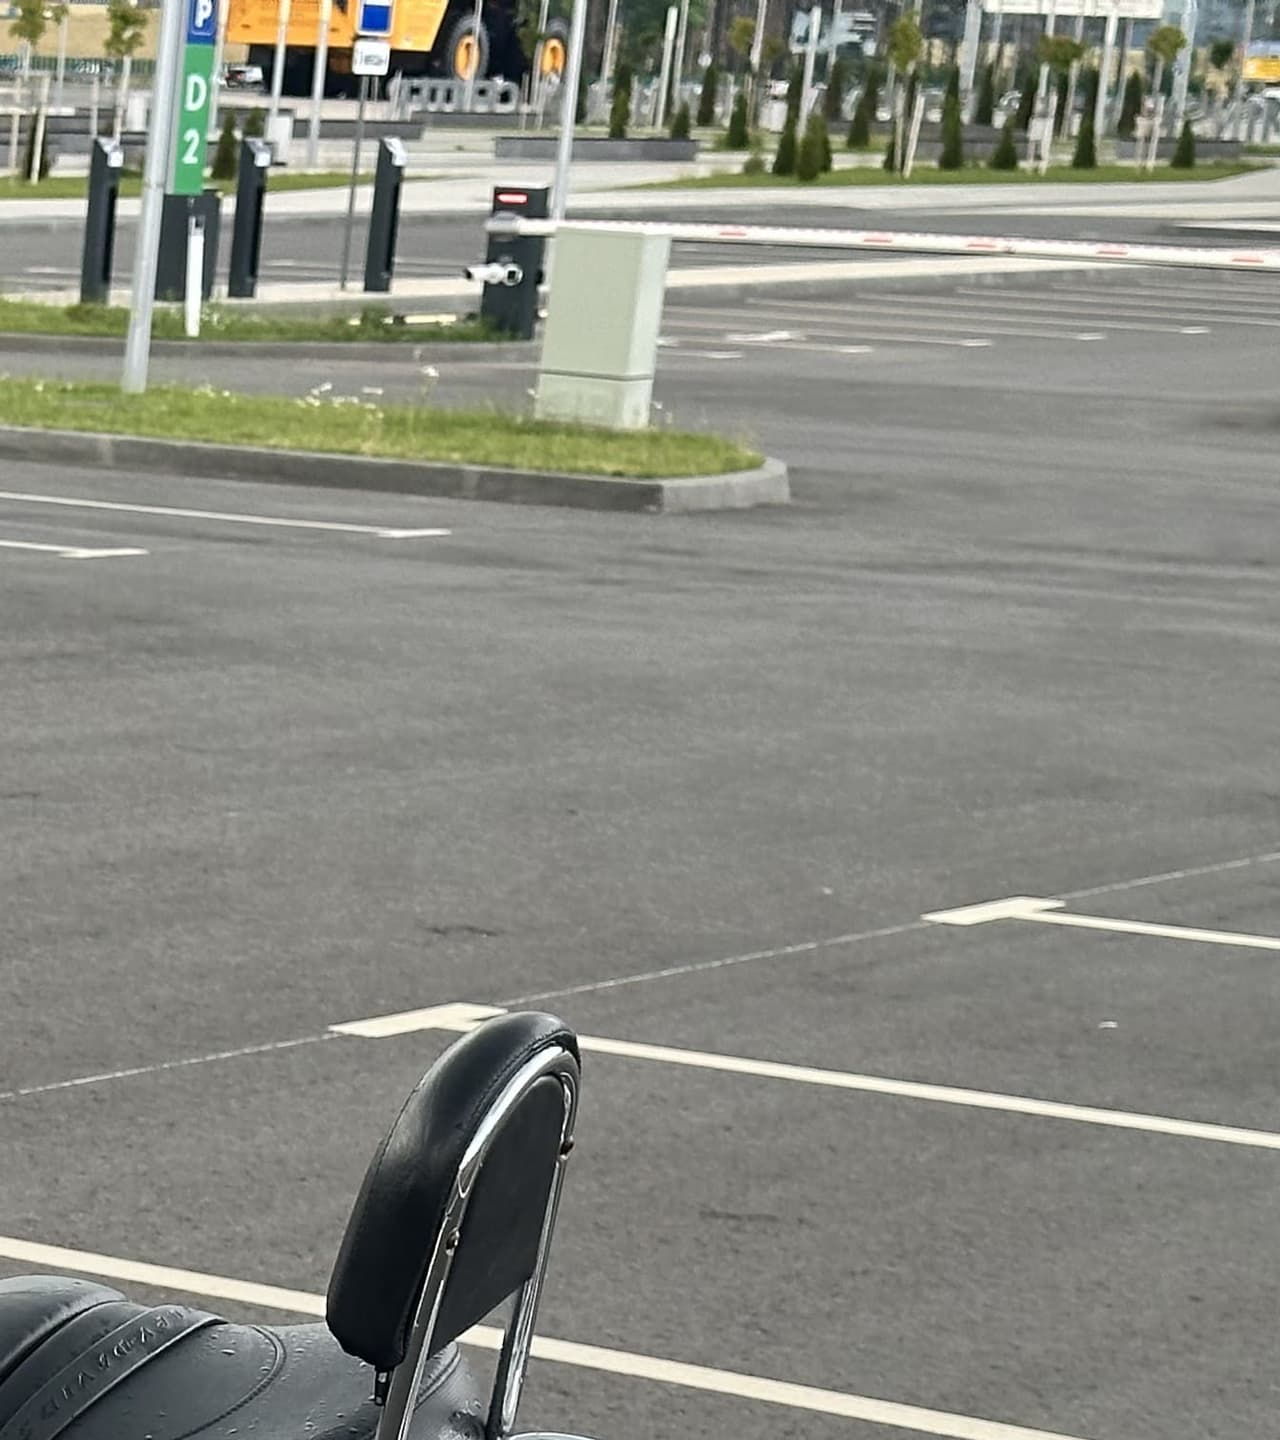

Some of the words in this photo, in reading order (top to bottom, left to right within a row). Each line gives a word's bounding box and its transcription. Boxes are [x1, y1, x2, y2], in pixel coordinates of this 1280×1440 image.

[194, 0, 213, 28] P
[184, 73, 207, 112] D
[182, 128, 200, 165] 2
